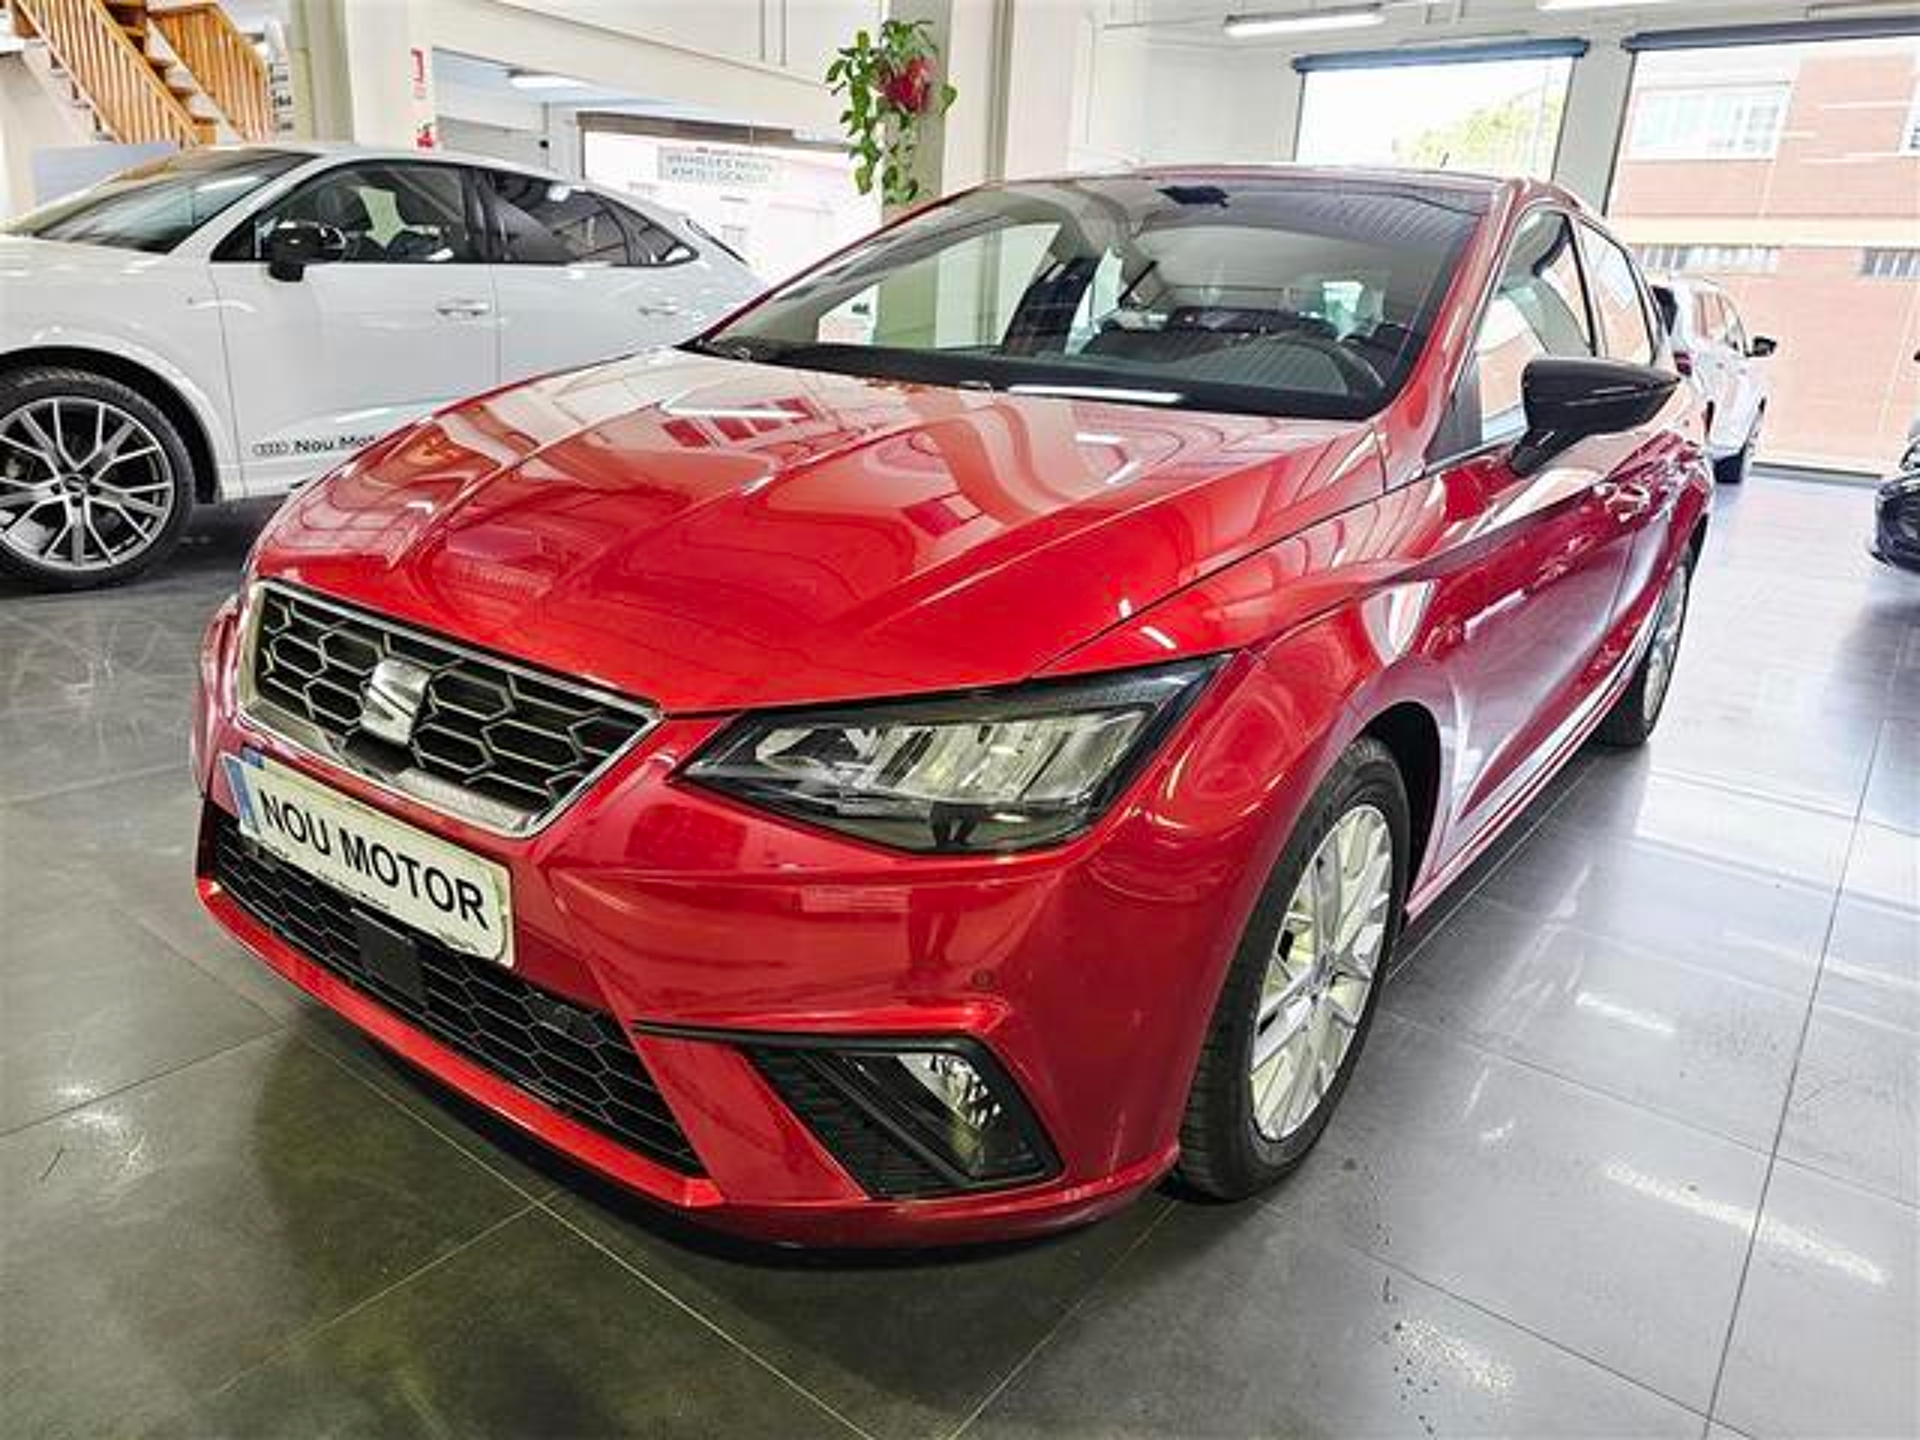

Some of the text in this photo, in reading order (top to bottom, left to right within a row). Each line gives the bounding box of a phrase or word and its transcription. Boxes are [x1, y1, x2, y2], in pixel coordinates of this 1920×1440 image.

[294, 440, 334, 454] Nou
[258, 788, 490, 931] NOU MOTOR
